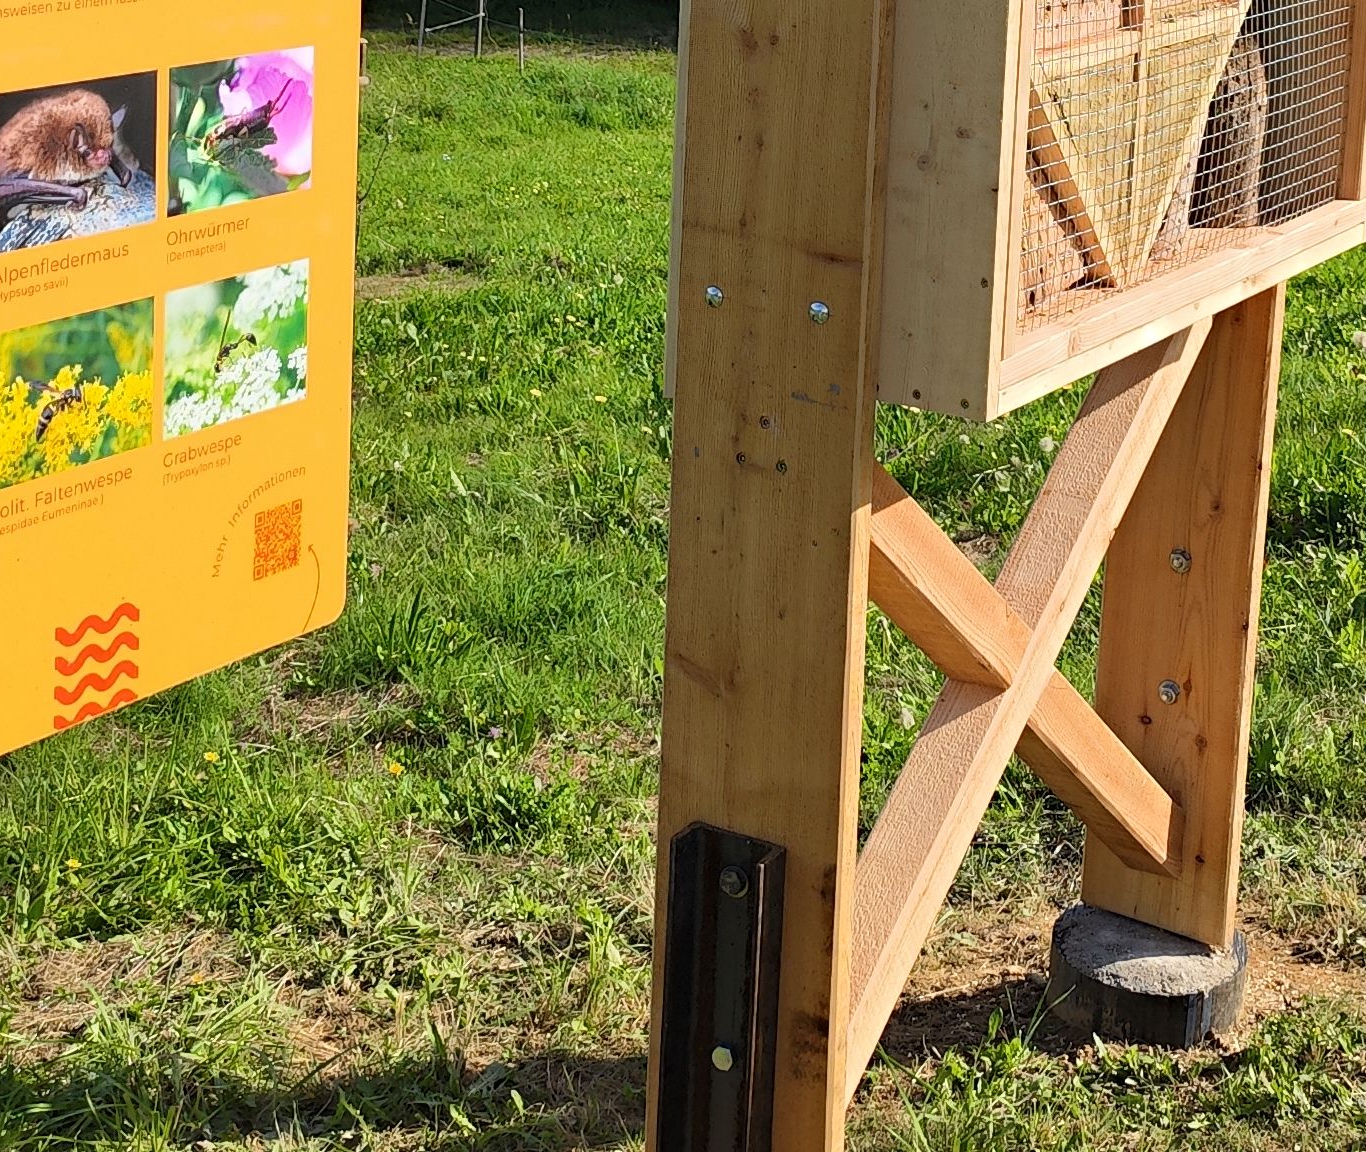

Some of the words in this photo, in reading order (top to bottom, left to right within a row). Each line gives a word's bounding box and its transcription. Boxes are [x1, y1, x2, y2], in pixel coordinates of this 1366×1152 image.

[57, 0, 71, 11] zu
[167, 218, 250, 246] Ohrwürmer
[43, 275, 69, 293] savii)
[163, 434, 241, 467] Grabwespe
[35, 467, 133, 508] Faltenwespe
[42, 497, 98, 521] Eumeninae
[212, 535, 228, 578] Mehr
[228, 466, 306, 527] Informationen
